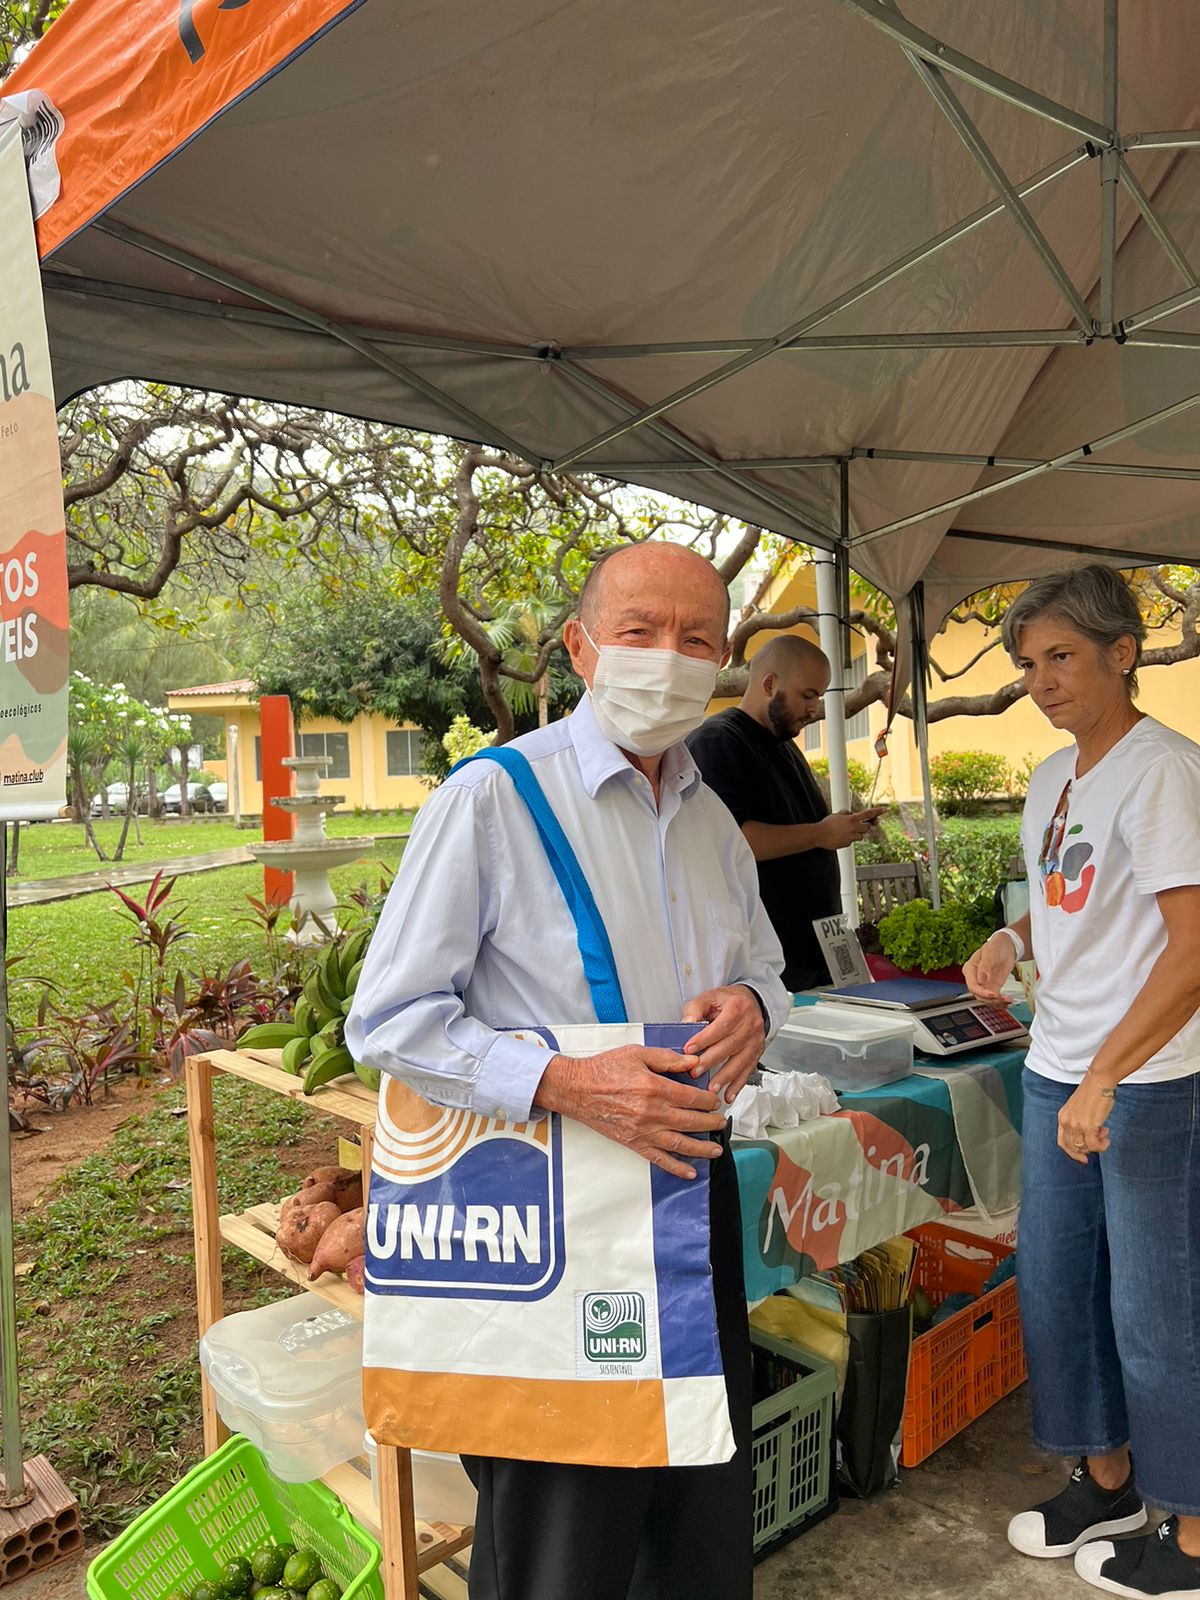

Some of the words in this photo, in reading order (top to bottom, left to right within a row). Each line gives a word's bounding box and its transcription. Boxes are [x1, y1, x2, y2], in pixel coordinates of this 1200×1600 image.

[0, 552, 39, 606] OS
[3, 769, 44, 784] matina.club
[821, 918, 845, 938] PIX
[763, 1143, 930, 1254] Matina
[366, 1204, 541, 1264] UNI-RN
[589, 1337, 641, 1354] UNI-RN
[600, 1362, 632, 1375] SUSTENTÁVEL
